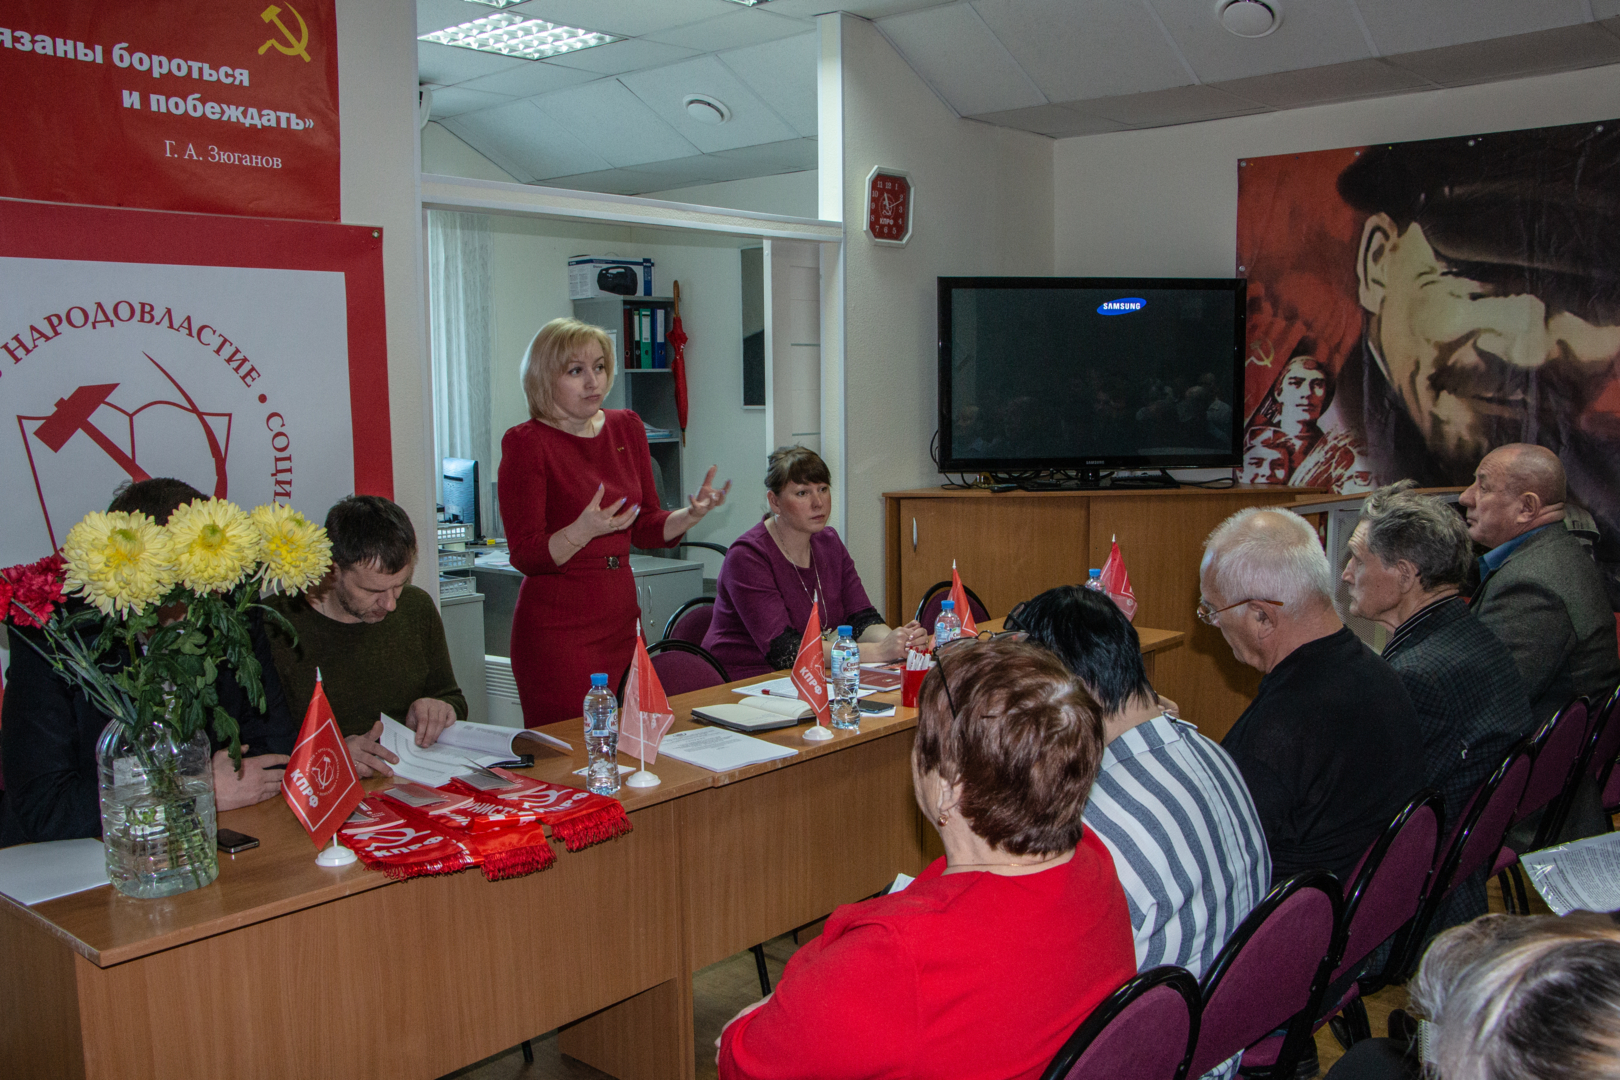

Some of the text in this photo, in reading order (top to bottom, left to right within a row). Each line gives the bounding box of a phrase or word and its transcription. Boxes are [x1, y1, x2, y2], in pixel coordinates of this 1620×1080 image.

[112, 42, 250, 87] бороться
[122, 89, 315, 130] и побеждать»
[164, 140, 283, 169] Г. А. Зюганов
[1103, 302, 1141, 310] SAMSUNG
[0, 300, 261, 388] НАРОДОВЛАСТИЕ
[266, 412, 292, 508] СОЦИ
[799, 666, 822, 695] КПРФ
[290, 768, 319, 808] КПРФ
[372, 836, 444, 857] КПРФ
